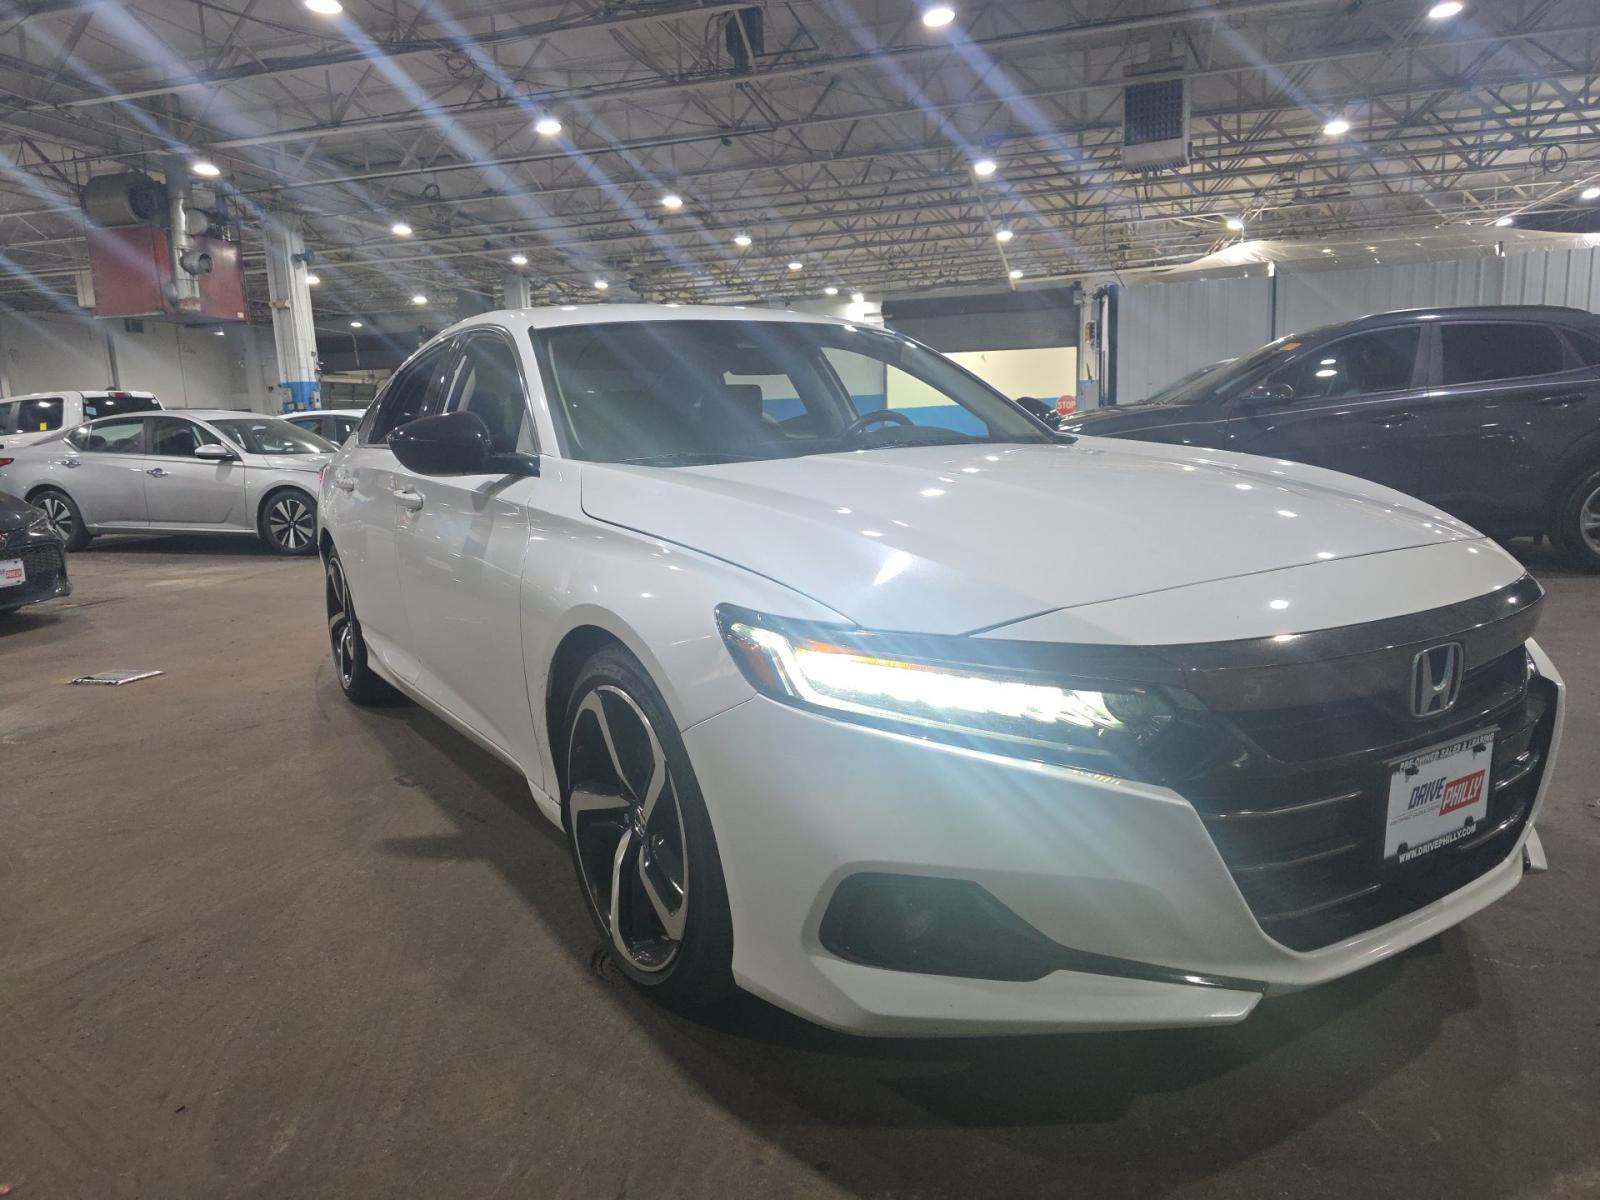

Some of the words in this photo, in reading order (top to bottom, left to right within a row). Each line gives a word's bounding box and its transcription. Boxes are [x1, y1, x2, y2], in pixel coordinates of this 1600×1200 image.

[1057, 399, 1076, 410] STOP
[1408, 777, 1447, 810] DRIVE
[1442, 774, 1485, 810] PHILLY
